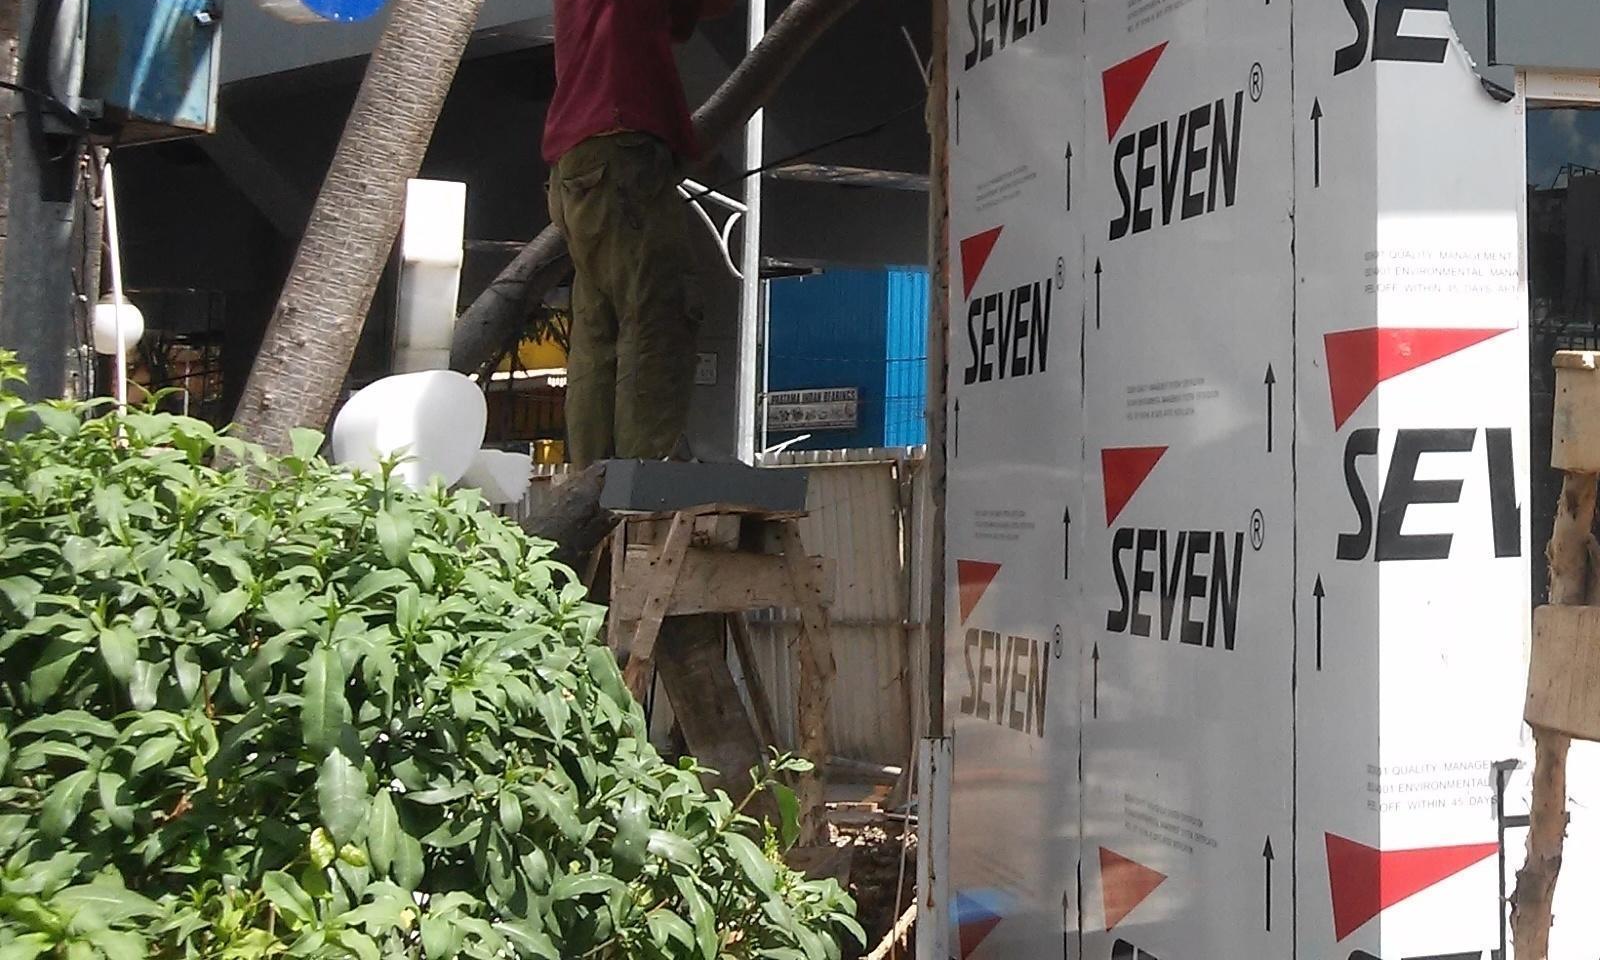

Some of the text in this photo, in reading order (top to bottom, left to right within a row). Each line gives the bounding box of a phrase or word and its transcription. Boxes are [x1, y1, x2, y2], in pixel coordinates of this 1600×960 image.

[1109, 90, 1244, 241] SEVEN
[964, 278, 1052, 385] SEVEN
[1106, 527, 1245, 651] SEVEN
[960, 628, 1050, 738] SEVEN
[1391, 763, 1437, 776] QUALITY
[1407, 799, 1446, 811] WITHIN
